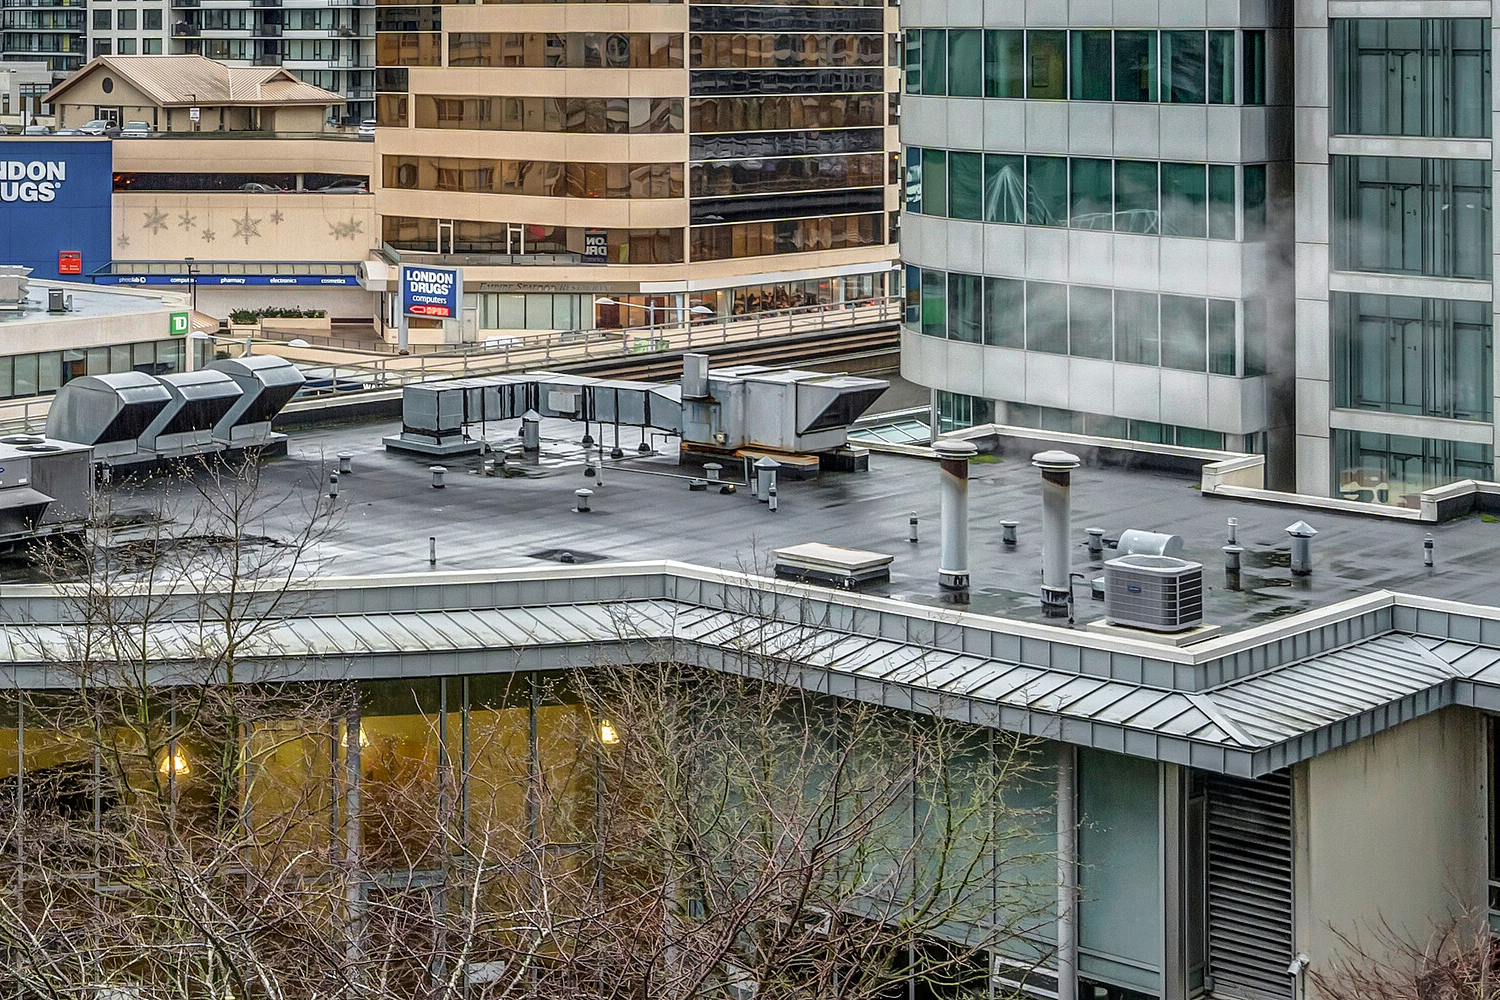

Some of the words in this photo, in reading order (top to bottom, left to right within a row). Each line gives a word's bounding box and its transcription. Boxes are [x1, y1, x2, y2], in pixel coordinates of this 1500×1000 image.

[220, 277, 246, 285] pharmacy
[406, 269, 454, 285] LONDON
[410, 281, 449, 296] DRUGS
[412, 295, 448, 305] computers
[172, 316, 188, 331] TD
